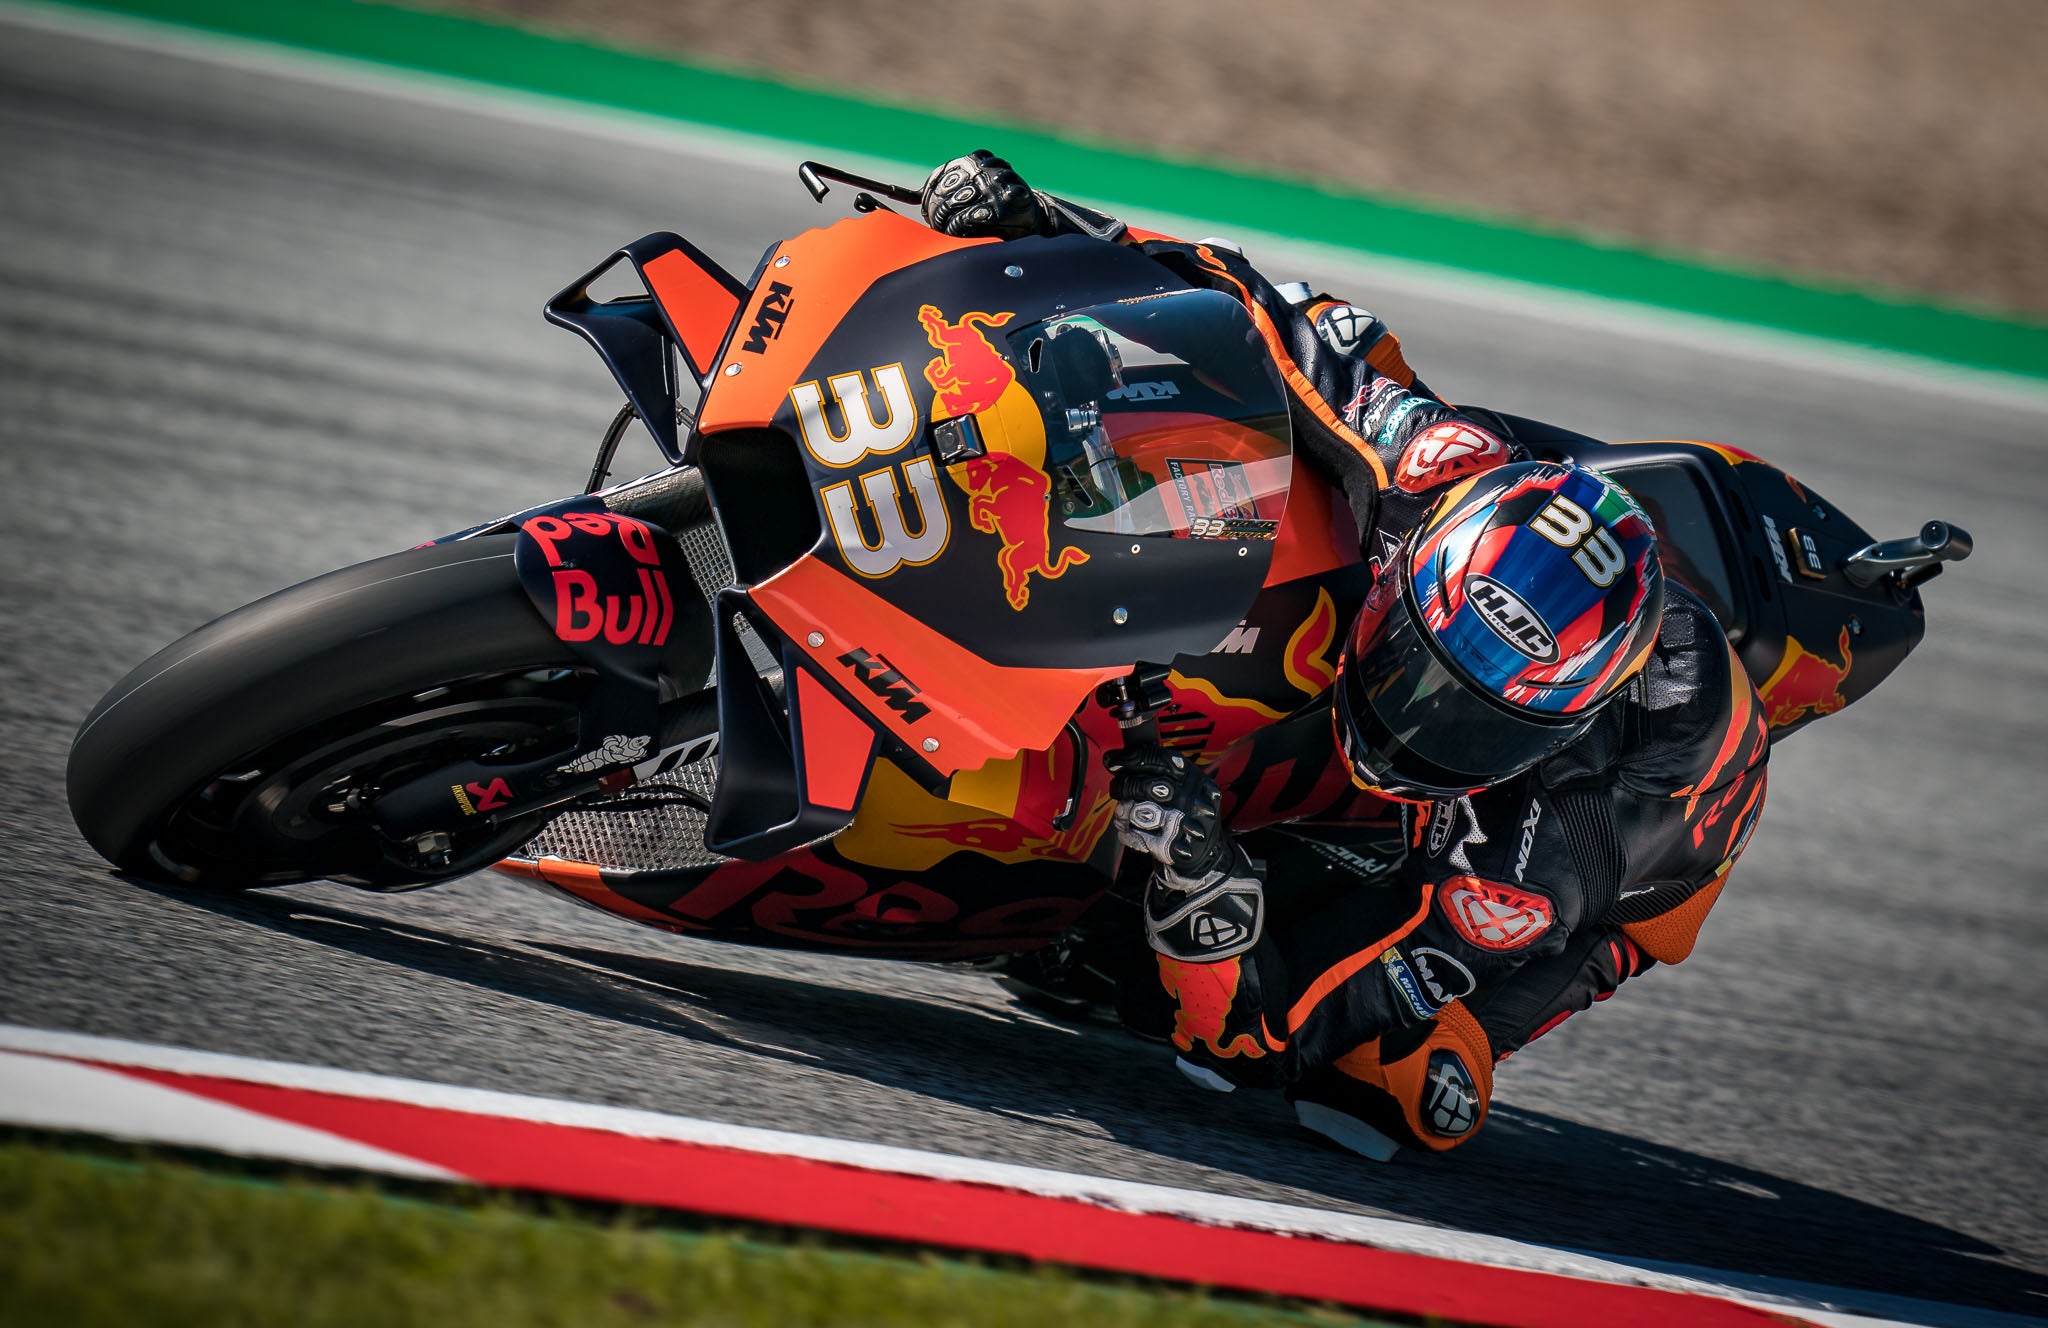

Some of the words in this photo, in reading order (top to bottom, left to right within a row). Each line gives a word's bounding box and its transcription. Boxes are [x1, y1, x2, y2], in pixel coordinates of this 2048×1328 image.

[743, 281, 794, 355] KTM
[1106, 380, 1181, 402] KTM
[789, 362, 951, 579] 33
[1170, 461, 1192, 502] FACTORY
[1191, 518, 1226, 536] 33
[1529, 495, 1626, 587] 33
[552, 568, 674, 647] Bull
[1470, 584, 1553, 653] HJC
[1486, 612, 1520, 644] HELMETS
[836, 647, 931, 726] KTM
